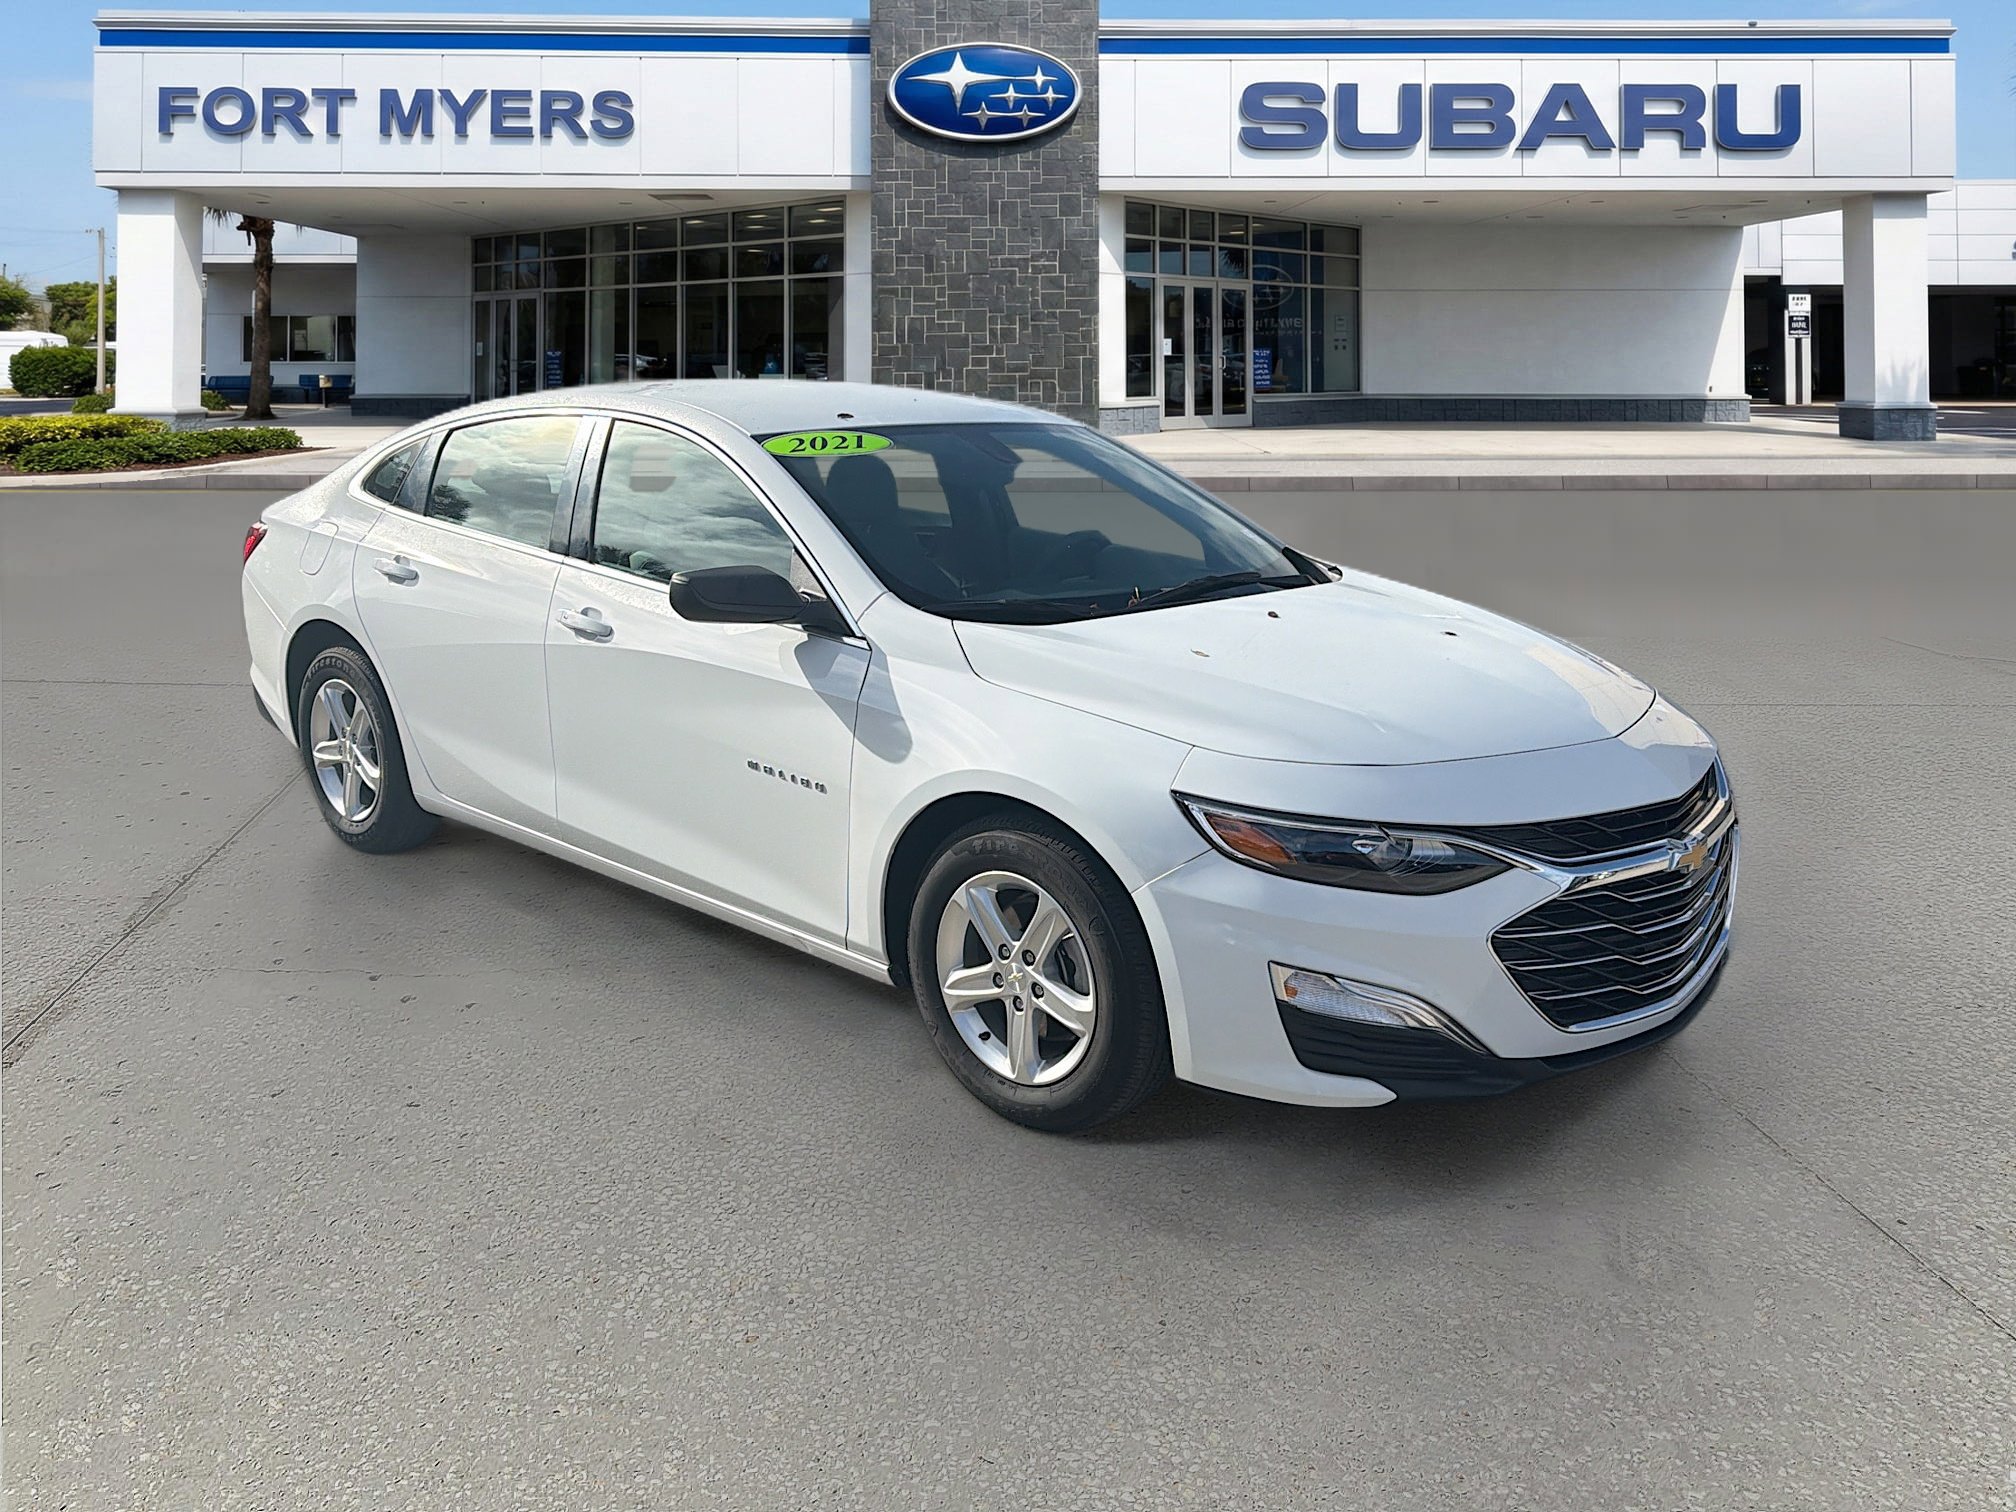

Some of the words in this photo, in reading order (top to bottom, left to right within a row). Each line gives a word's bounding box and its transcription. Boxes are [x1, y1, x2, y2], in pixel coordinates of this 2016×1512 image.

[158, 87, 356, 137] FORT
[379, 88, 635, 139] MYERS
[1240, 82, 1802, 151] SUBARU
[788, 434, 867, 454] 2021
